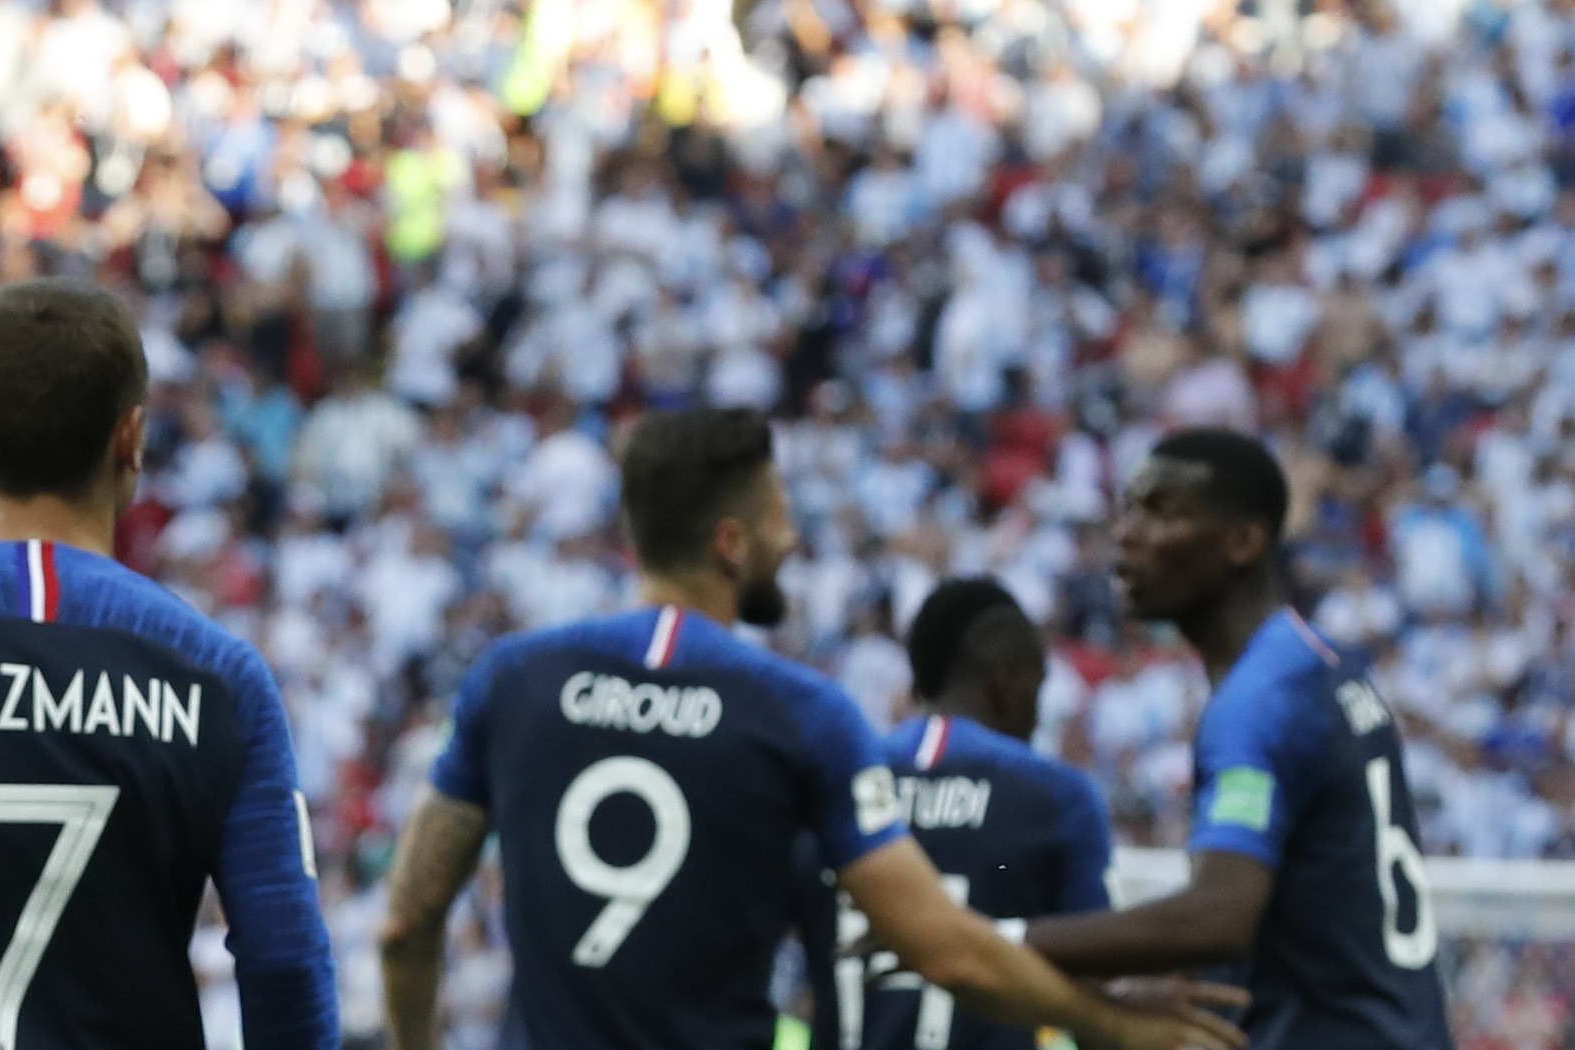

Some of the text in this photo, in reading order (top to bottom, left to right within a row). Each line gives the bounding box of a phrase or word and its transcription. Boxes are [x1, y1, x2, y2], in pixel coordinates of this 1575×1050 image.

[560, 671, 723, 738] GIROUD
[555, 756, 691, 968] 9
[1366, 757, 1437, 970] 6
